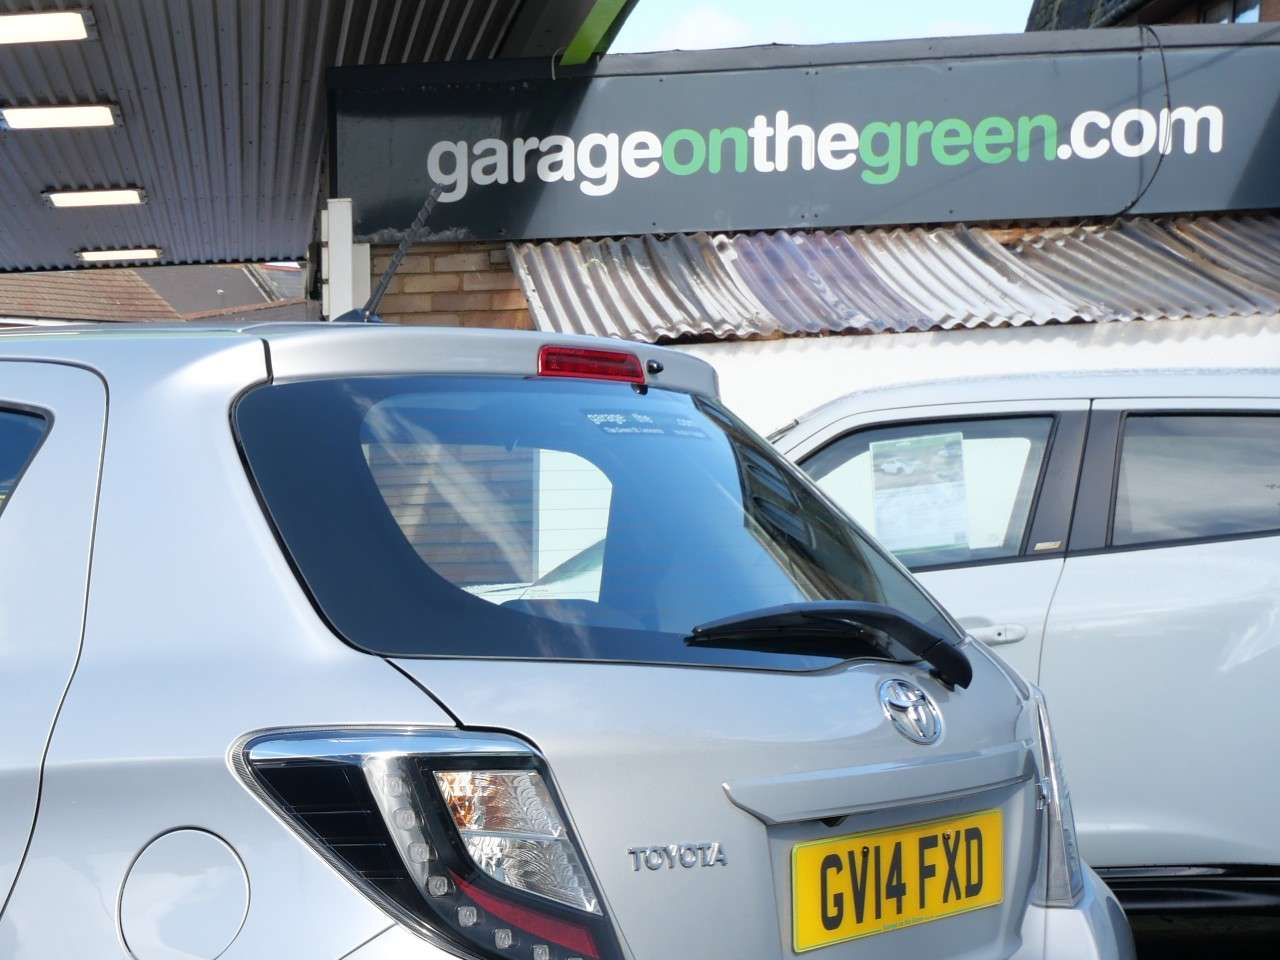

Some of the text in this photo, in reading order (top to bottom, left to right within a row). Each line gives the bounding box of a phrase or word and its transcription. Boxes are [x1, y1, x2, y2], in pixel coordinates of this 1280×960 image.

[426, 104, 1223, 203] garageonthegreen.com
[626, 841, 728, 872] TOYOTA
[820, 826, 984, 930] GV14 FXD
